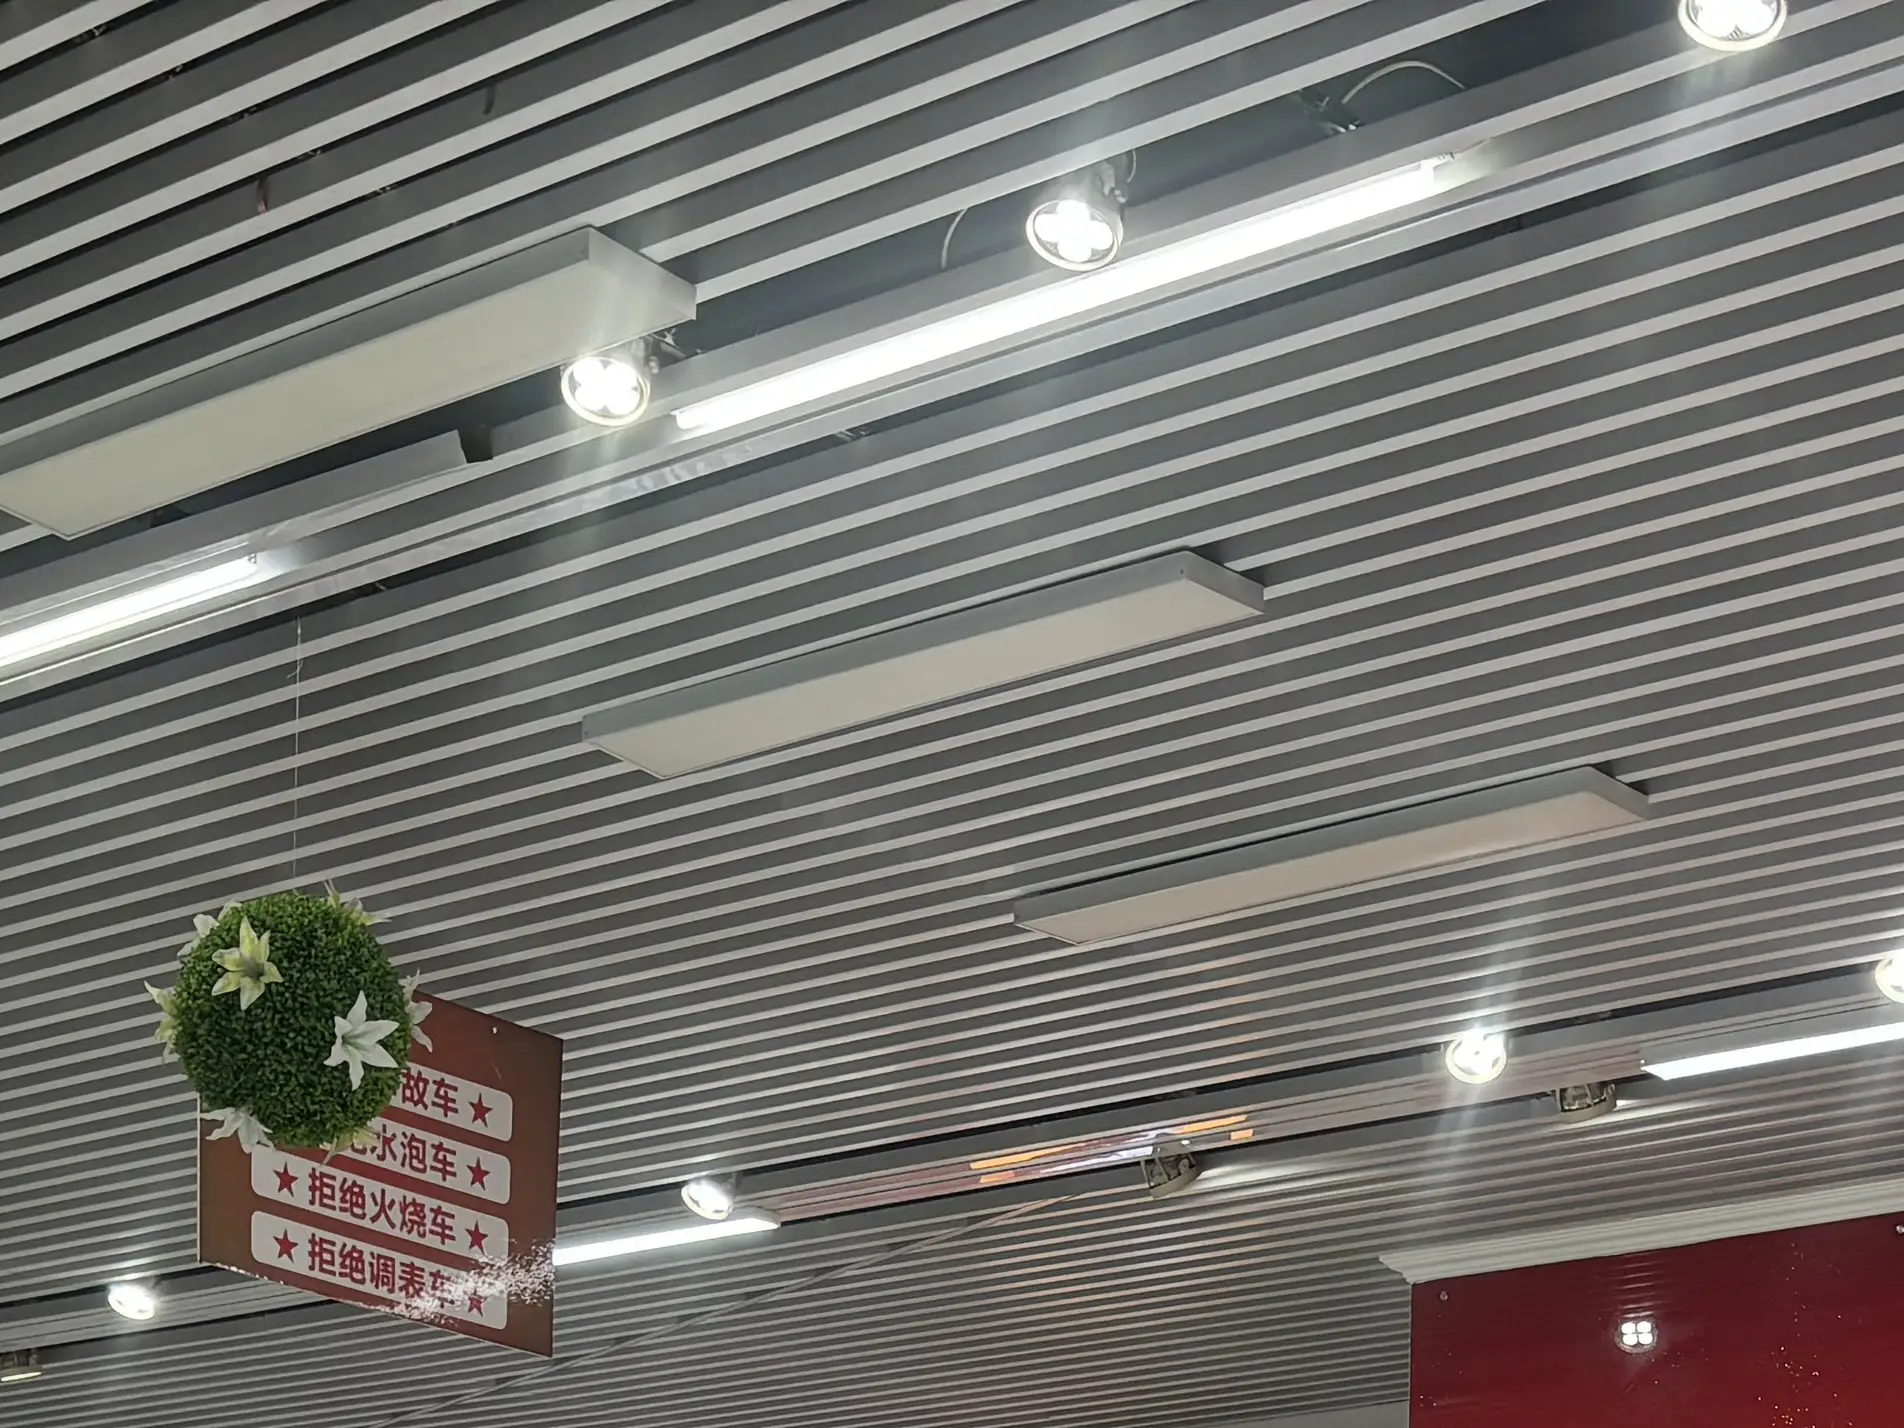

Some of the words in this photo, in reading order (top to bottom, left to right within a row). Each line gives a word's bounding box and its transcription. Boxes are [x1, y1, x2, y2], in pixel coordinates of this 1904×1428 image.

[308, 1168, 457, 1247] 拒绝火烧车
[308, 1233, 456, 1310] 拒绝调表车
